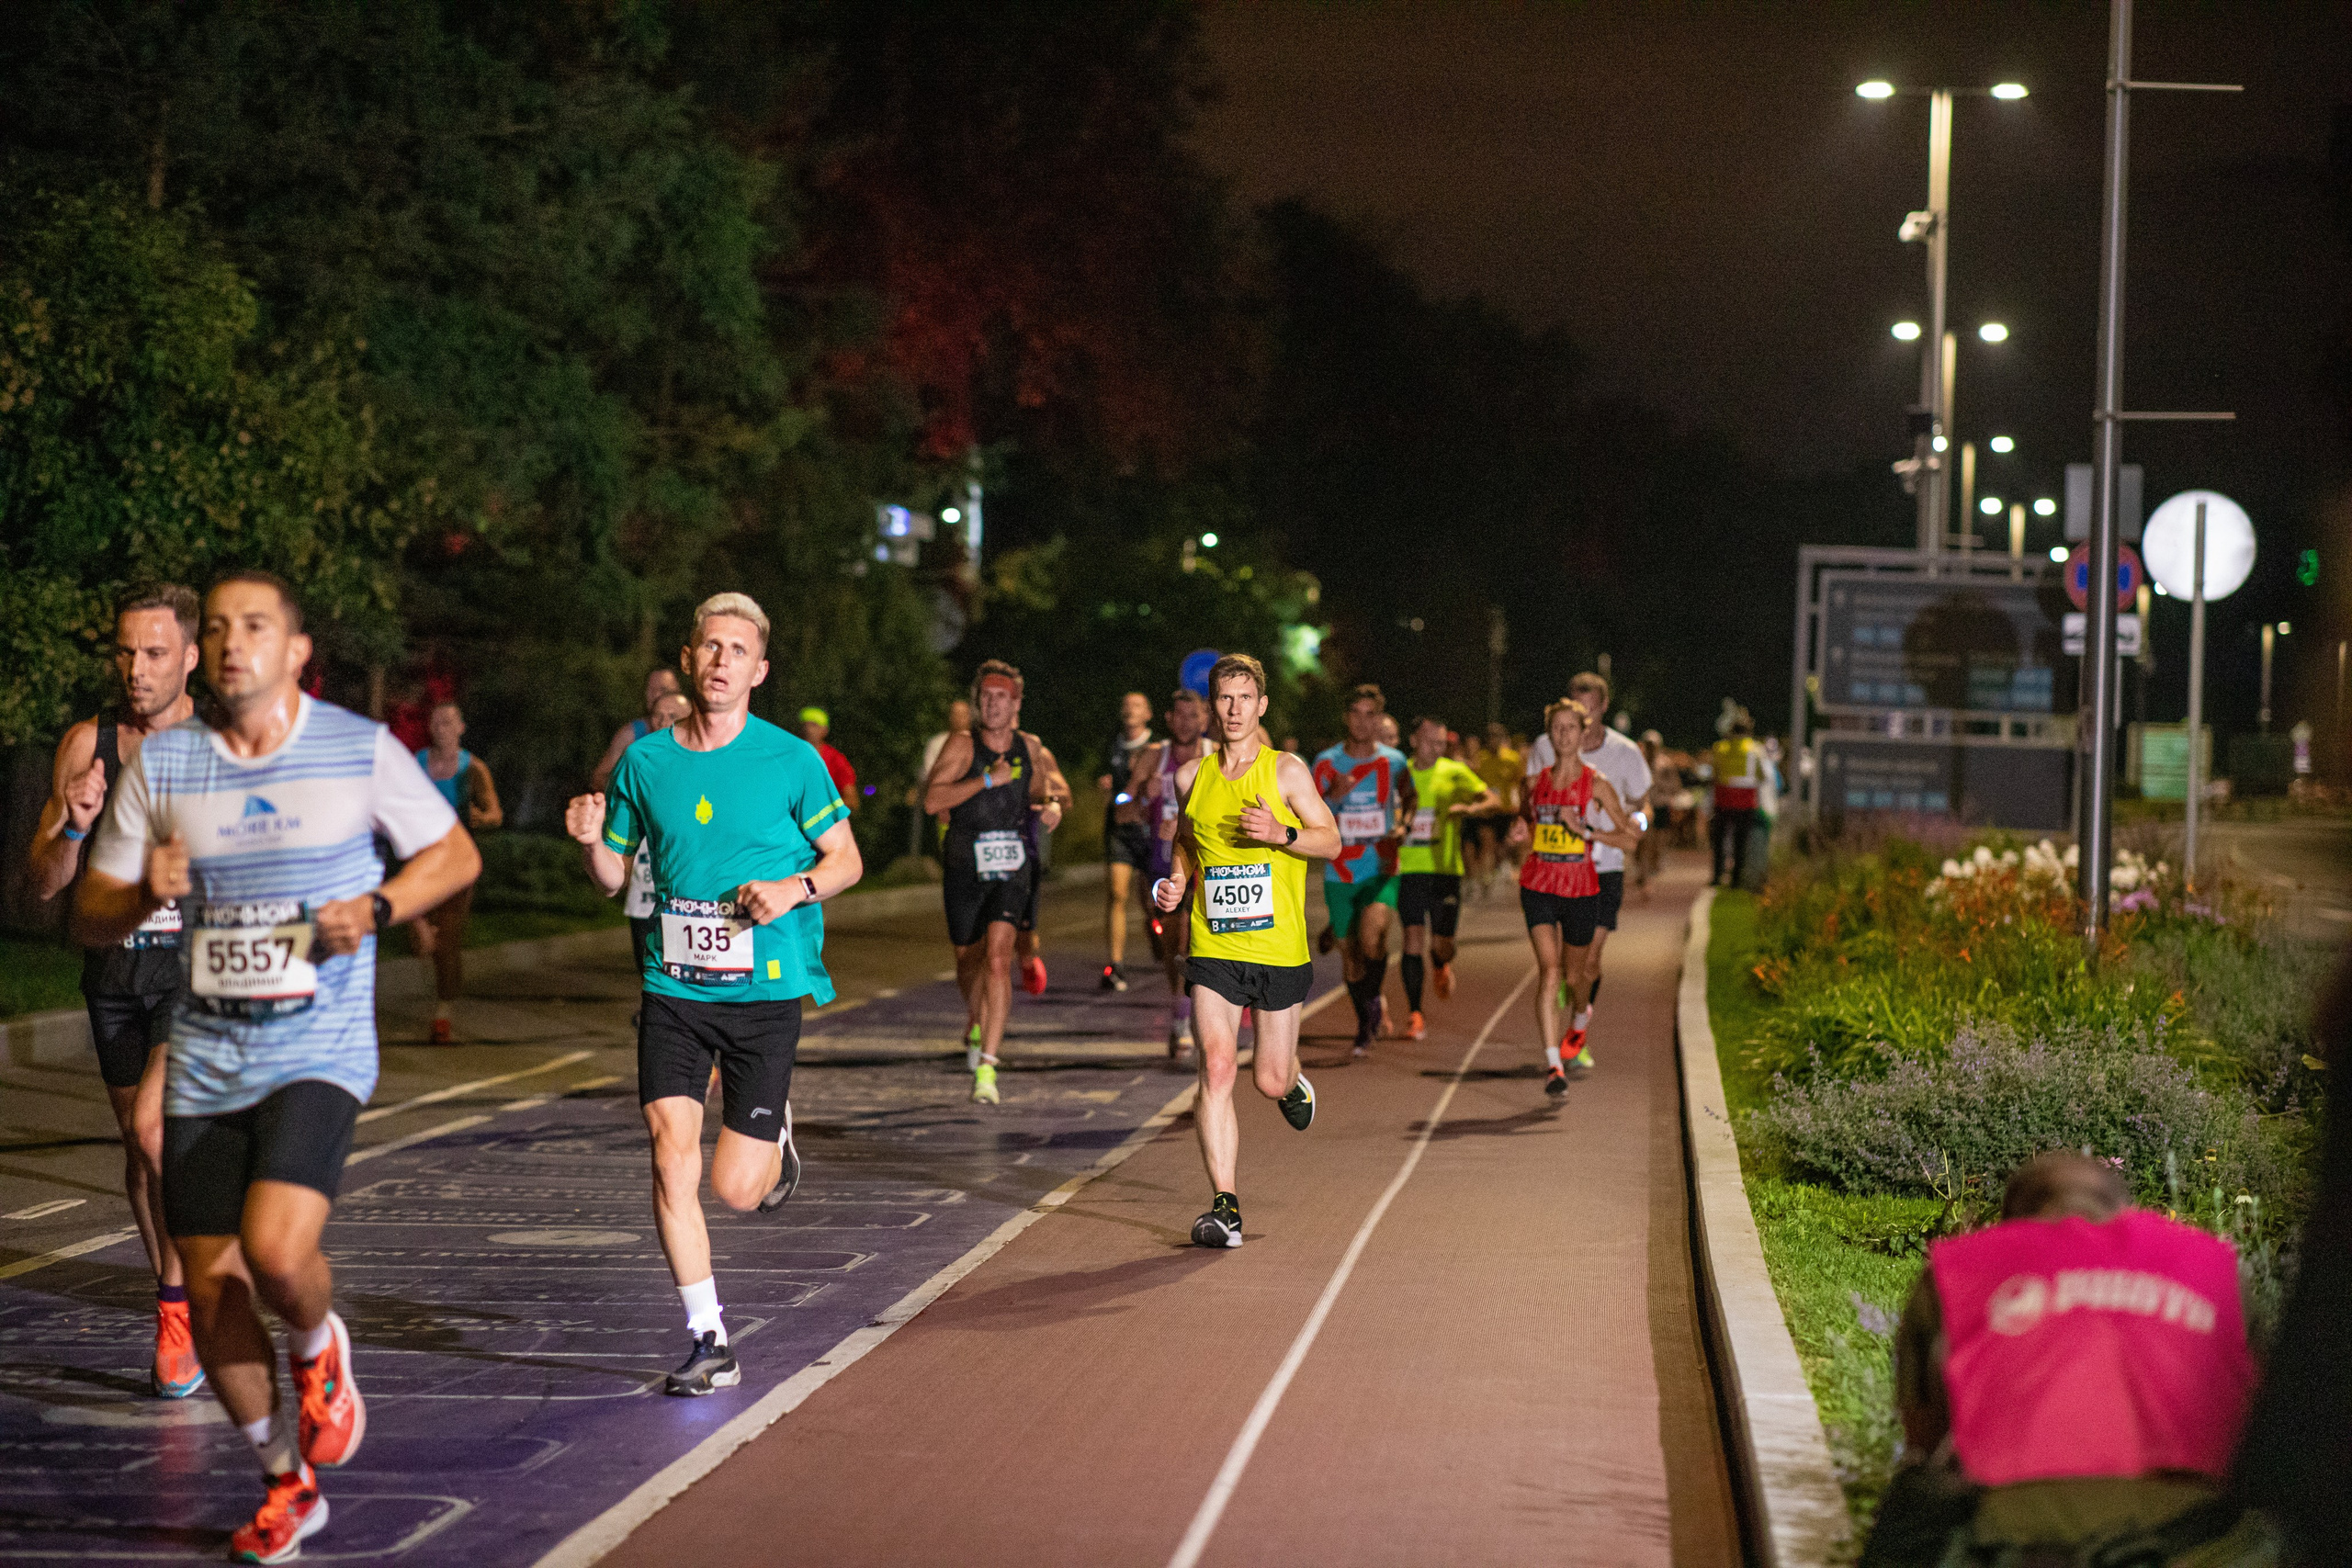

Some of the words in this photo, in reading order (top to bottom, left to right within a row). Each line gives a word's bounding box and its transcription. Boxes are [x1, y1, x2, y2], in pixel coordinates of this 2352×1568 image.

[1544, 829, 1577, 844] 141
[983, 845, 1019, 862] 5035
[1213, 884, 1263, 906] 4509
[1225, 906, 1250, 914] ALEXEY
[683, 924, 730, 952] 135
[208, 937, 294, 975] 5557
[694, 953, 718, 962] МАРК
